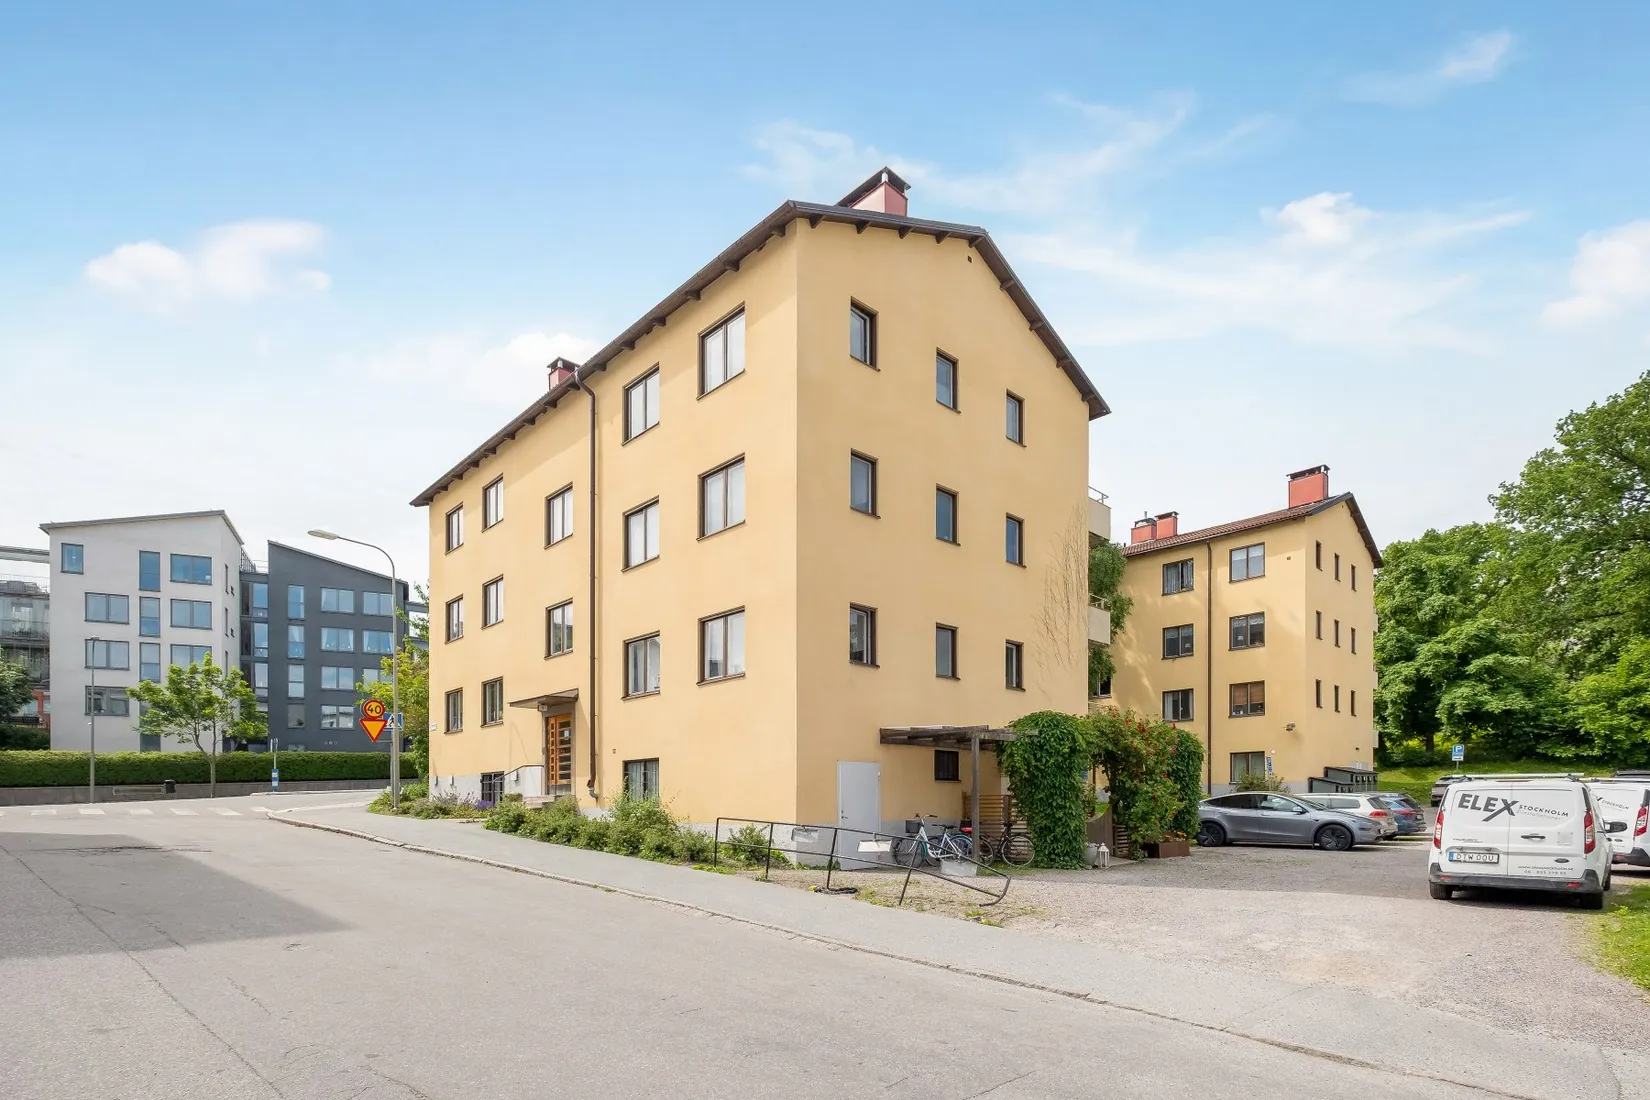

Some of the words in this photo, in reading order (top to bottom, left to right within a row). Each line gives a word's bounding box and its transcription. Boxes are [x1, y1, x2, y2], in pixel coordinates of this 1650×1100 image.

[367, 704, 382, 714] 40
[1458, 793, 1519, 822] ELEX
[1519, 804, 1568, 817] STOCKHOLM
